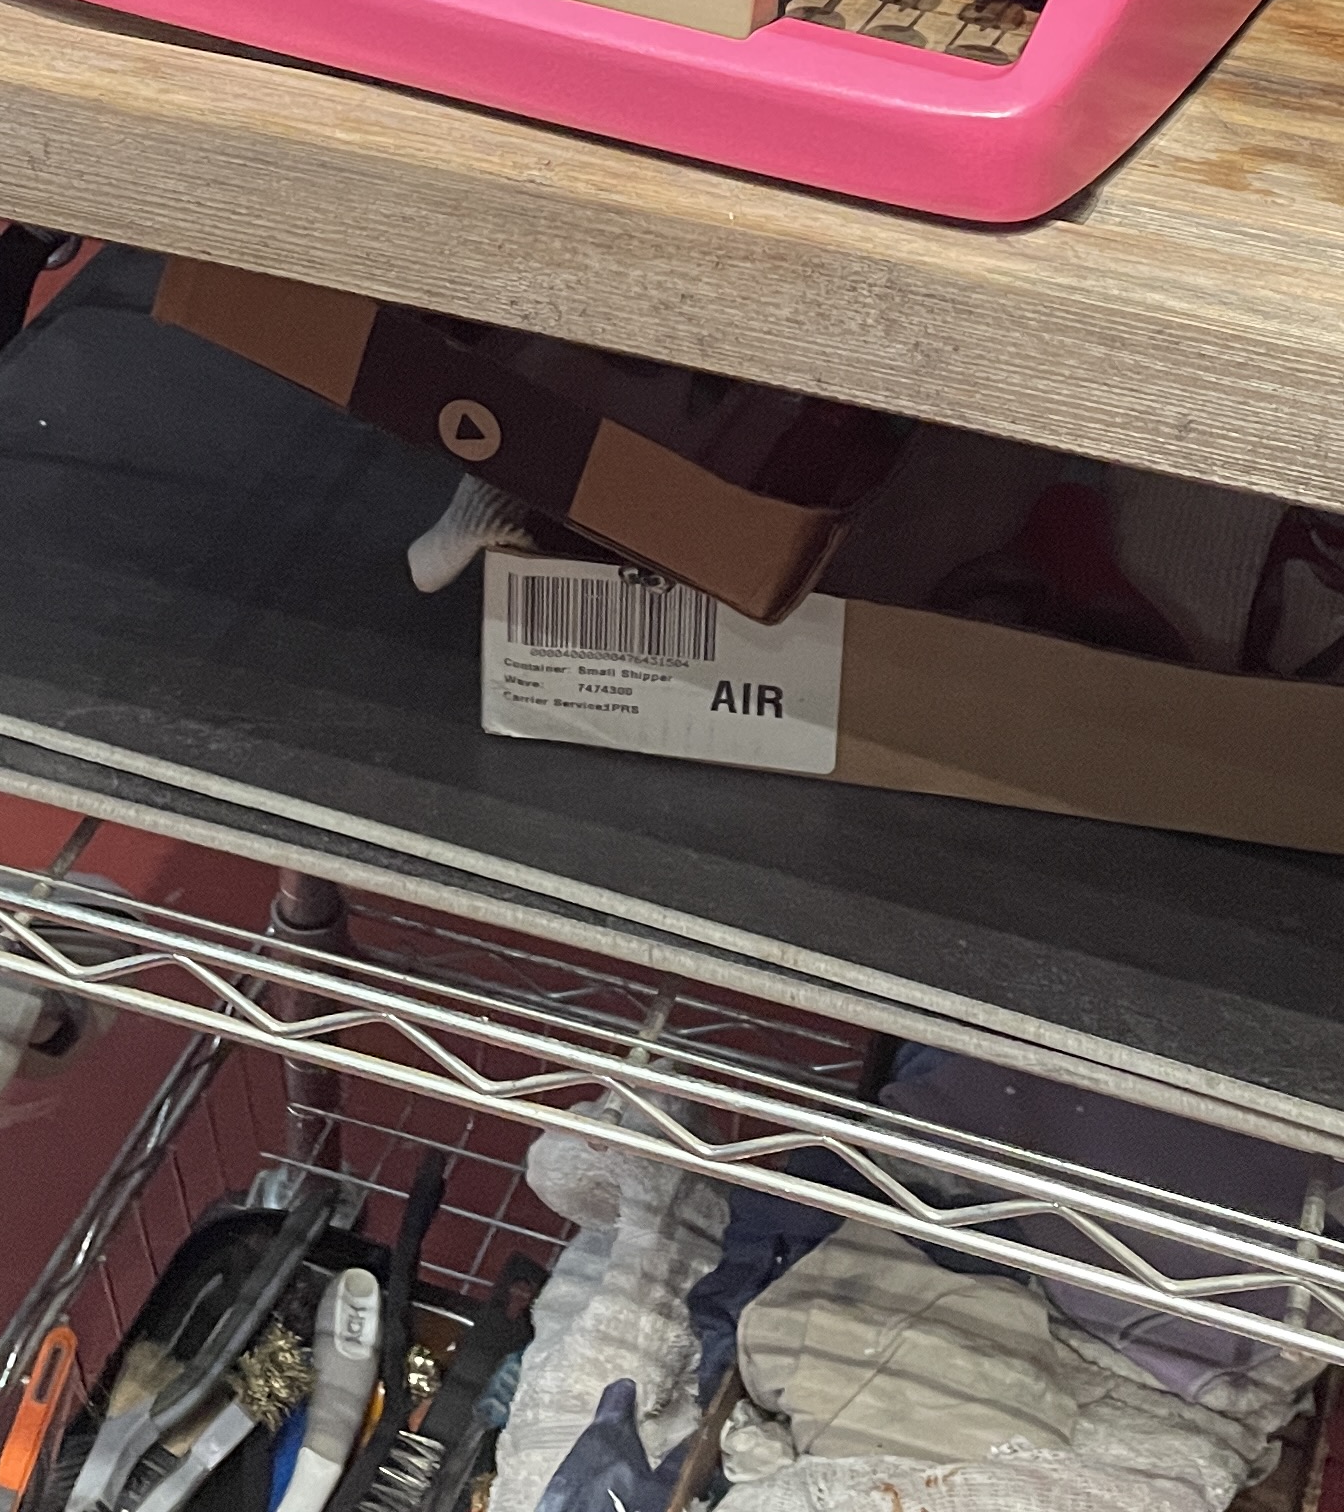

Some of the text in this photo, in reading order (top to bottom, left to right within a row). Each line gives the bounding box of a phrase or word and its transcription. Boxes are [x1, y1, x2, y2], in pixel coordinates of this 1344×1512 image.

[578, 665, 616, 678] Small
[621, 669, 674, 683] Shipper
[503, 691, 549, 706] Carrier
[709, 679, 784, 720] AIR
